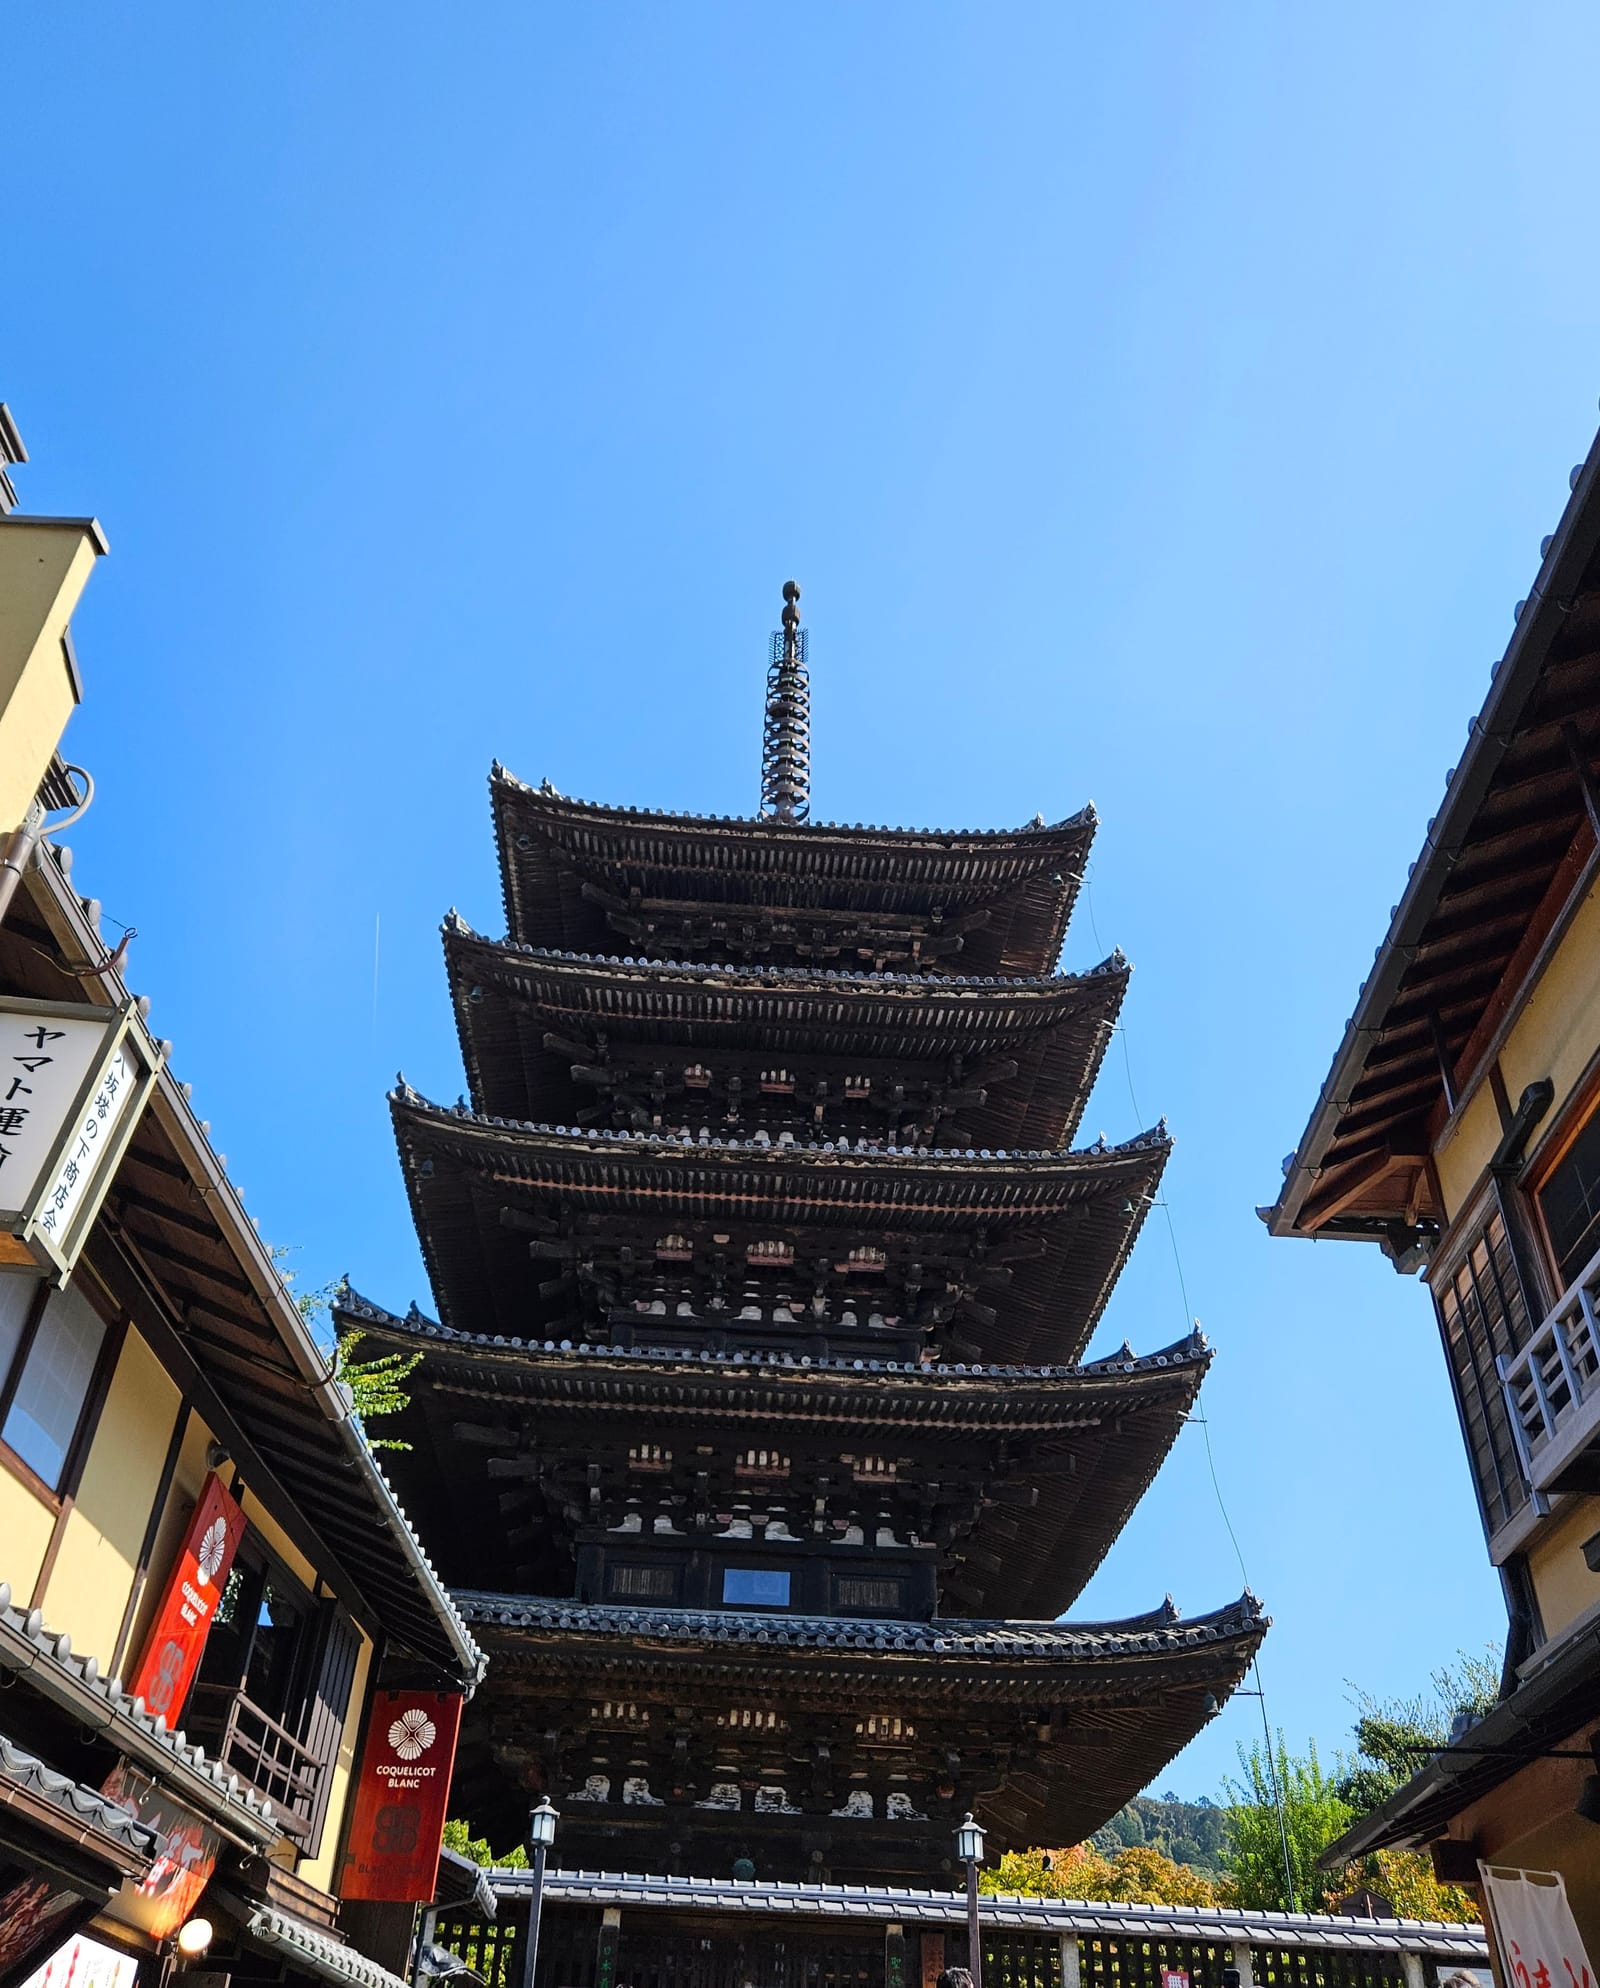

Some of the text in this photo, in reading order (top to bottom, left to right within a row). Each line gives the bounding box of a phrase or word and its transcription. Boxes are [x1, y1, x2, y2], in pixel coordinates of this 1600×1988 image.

[0, 1026, 66, 1168] ヤマト運
[40, 1054, 125, 1234] 八坂塔の下商店会
[376, 1765, 436, 1777] COQUELICOT
[388, 1778, 420, 1788] BLANC
